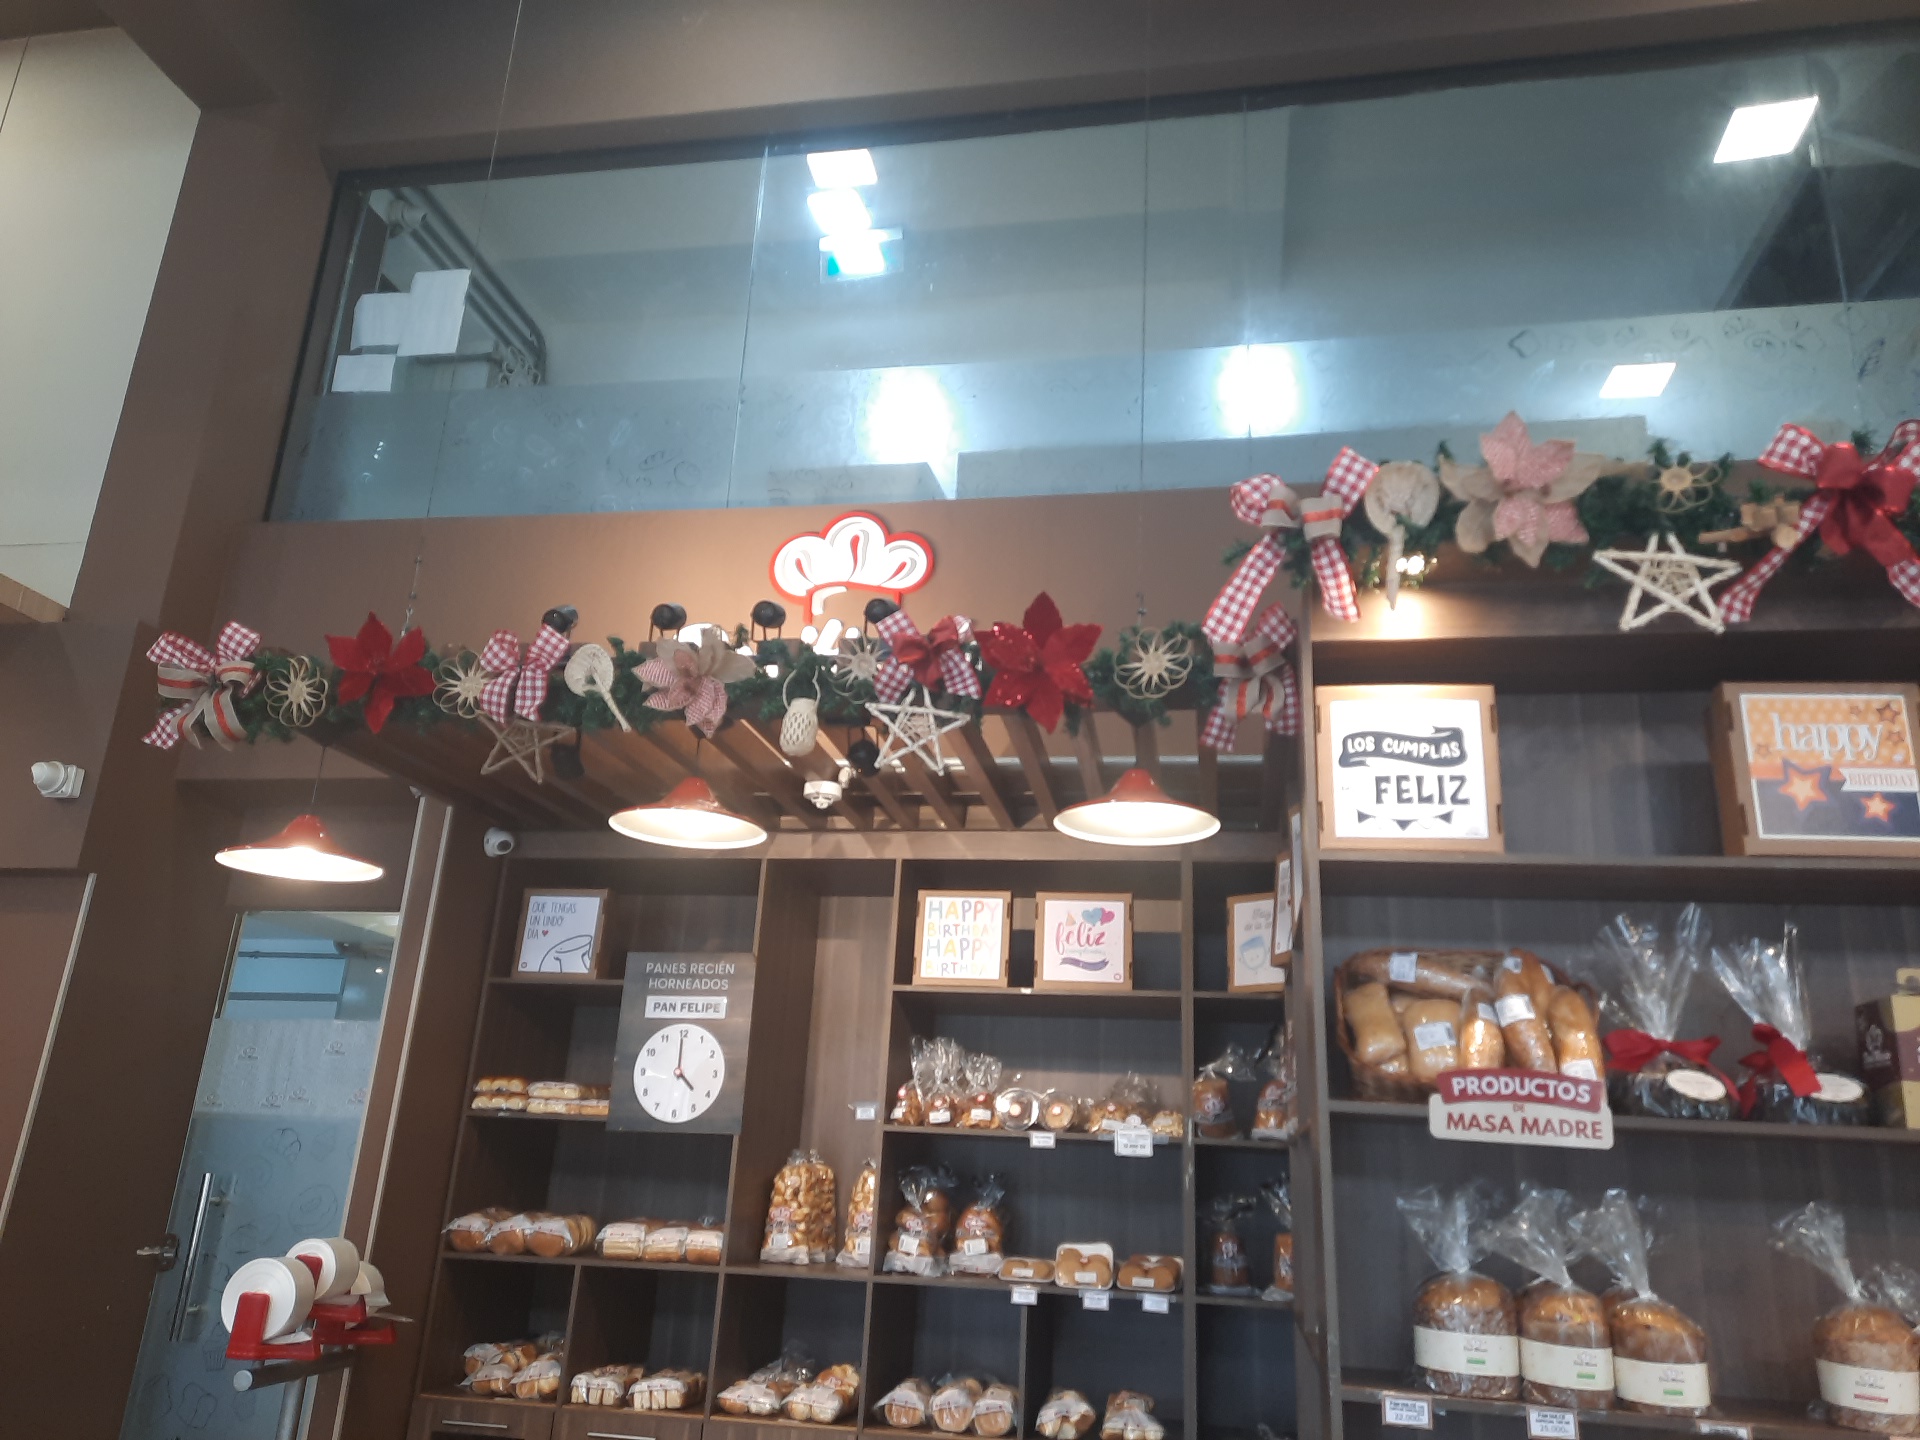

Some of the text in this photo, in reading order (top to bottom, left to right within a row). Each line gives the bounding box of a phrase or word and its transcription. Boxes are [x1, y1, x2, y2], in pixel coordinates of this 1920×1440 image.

[1770, 711, 1884, 761] happy
[1347, 735, 1461, 760] LOS CUMPLAS
[1850, 773, 1915, 787] BIRTHDAY
[1375, 774, 1470, 805] FELIZ
[531, 901, 577, 914] QUE TENGAS
[928, 899, 1000, 923] HAPPY
[529, 915, 564, 926] UN LINDO
[927, 922, 998, 937] BIRTHDAY
[1055, 921, 1106, 955] feliz
[926, 937, 998, 960] HAPPY
[646, 960, 735, 975] PANES RECIÉN
[648, 978, 729, 990] HORNEADOS
[653, 1002, 721, 1013] PAN FELIPE
[661, 1034, 669, 1043] 11
[680, 1029, 689, 1038] 12
[699, 1035, 704, 1044] 1
[646, 1048, 656, 1057] 10
[709, 1050, 715, 1058] 2
[640, 1067, 646, 1076] 9
[712, 1070, 718, 1078] 3
[642, 1088, 648, 1097] 8
[705, 1090, 711, 1098] 4
[1452, 1076, 1591, 1104] PRODUCTOS
[654, 1103, 660, 1111] 7
[1447, 1112, 1603, 1140] MASA MADRE
